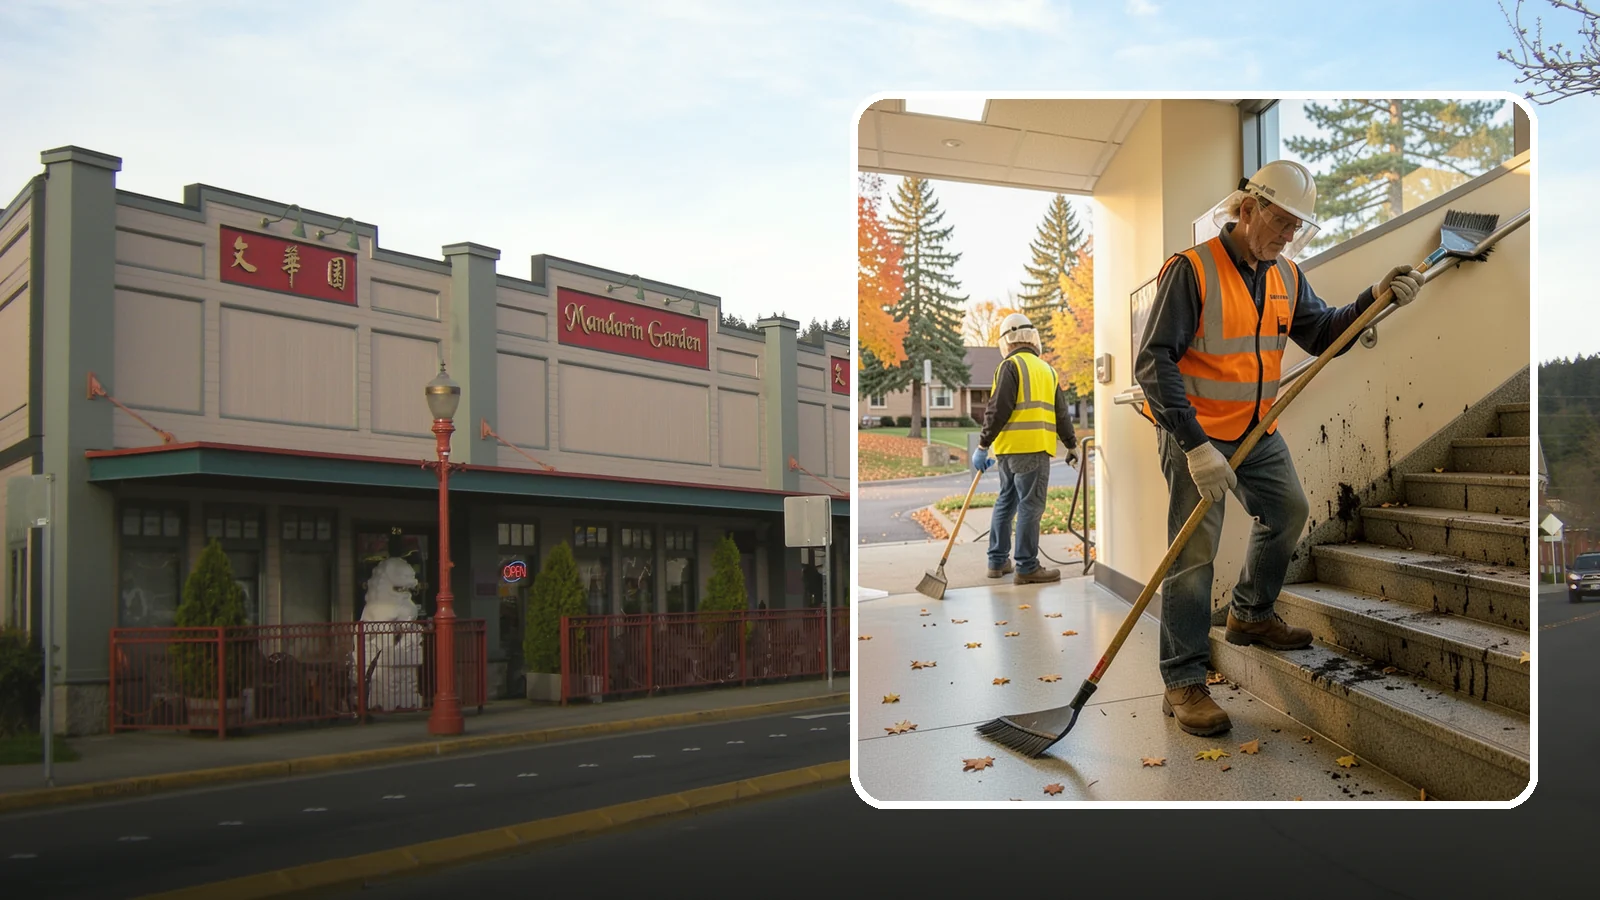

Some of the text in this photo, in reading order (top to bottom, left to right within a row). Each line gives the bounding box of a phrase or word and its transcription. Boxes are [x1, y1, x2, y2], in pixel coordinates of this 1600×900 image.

[231, 236, 346, 291] 文華園
[565, 302, 701, 352] Mandarin Garden
[503, 565, 527, 578] OPEN
